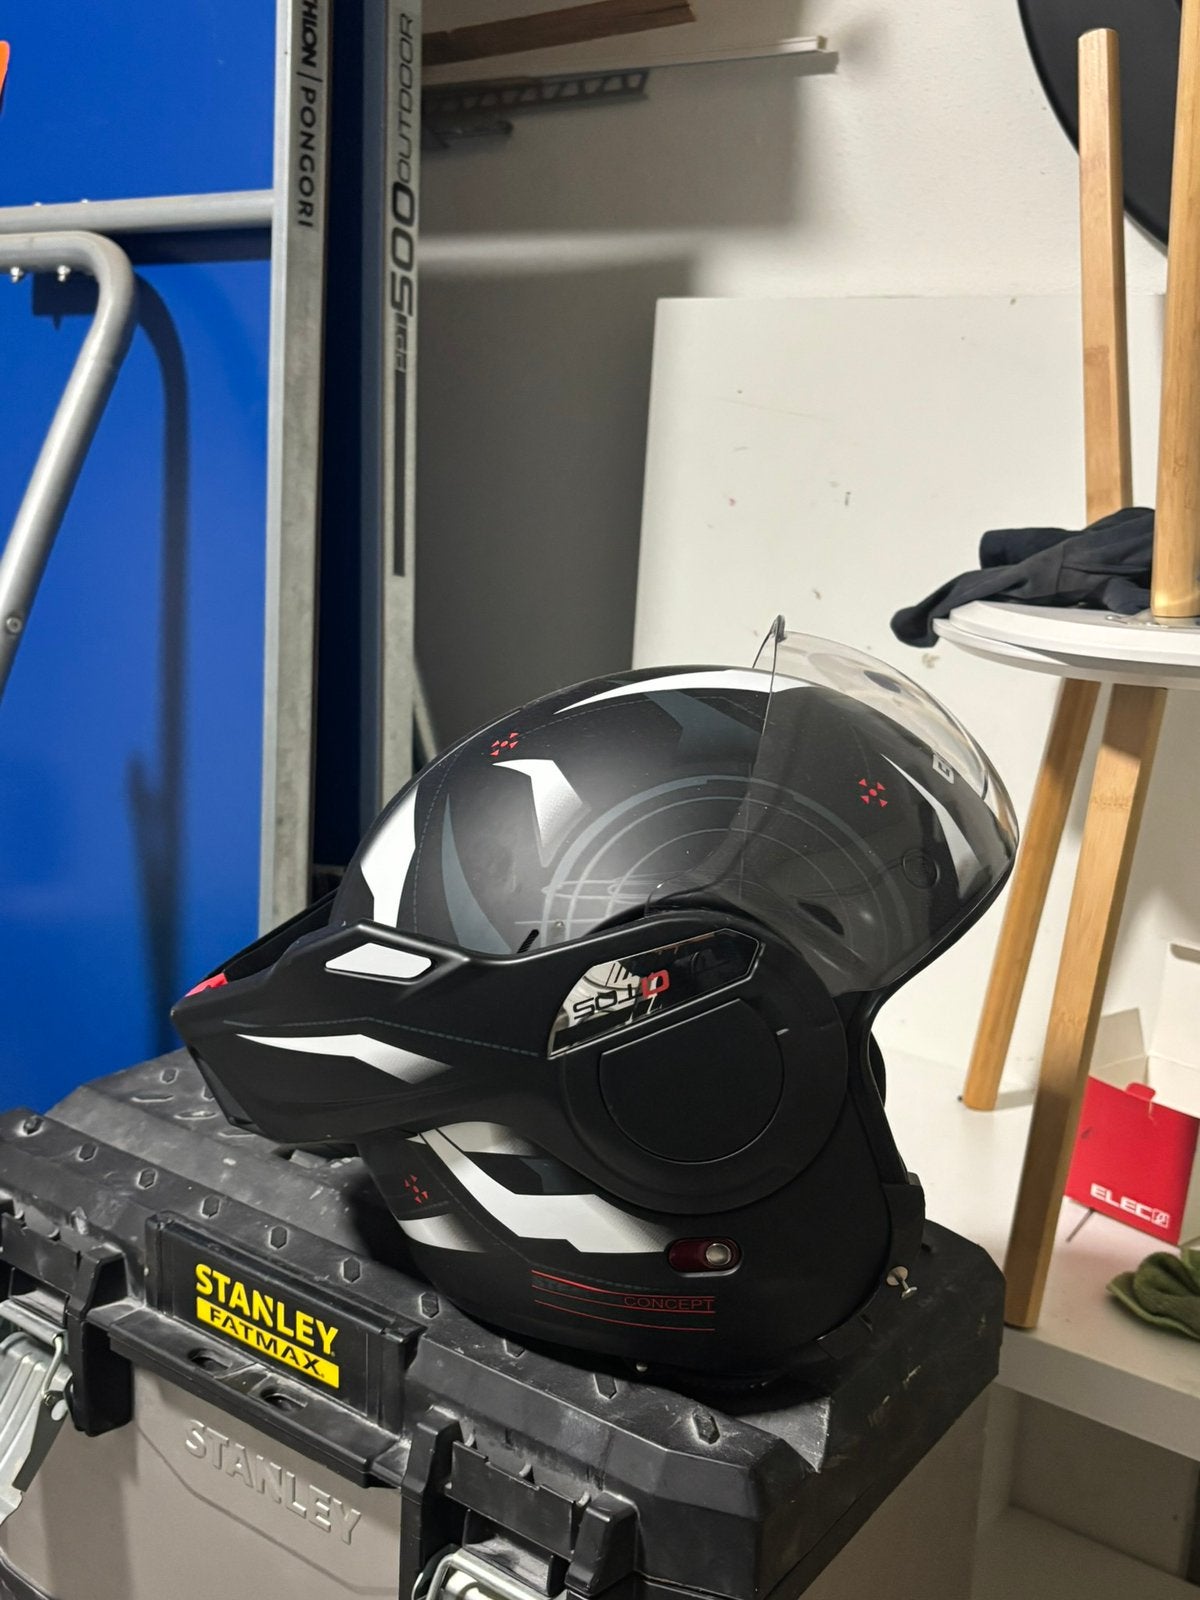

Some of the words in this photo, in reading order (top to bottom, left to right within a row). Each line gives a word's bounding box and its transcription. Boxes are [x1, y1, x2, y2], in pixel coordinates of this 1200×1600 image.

[301, 0, 318, 67] HLON
[396, 13, 413, 183] OUTDOOR
[297, 86, 316, 228] PONGORI
[390, 181, 414, 317] 500
[195, 1263, 339, 1355] STANLEY
[210, 1306, 321, 1377] FATMAX
[623, 1296, 714, 1311] CONCEPT
[184, 1419, 361, 1545] STANLEY
